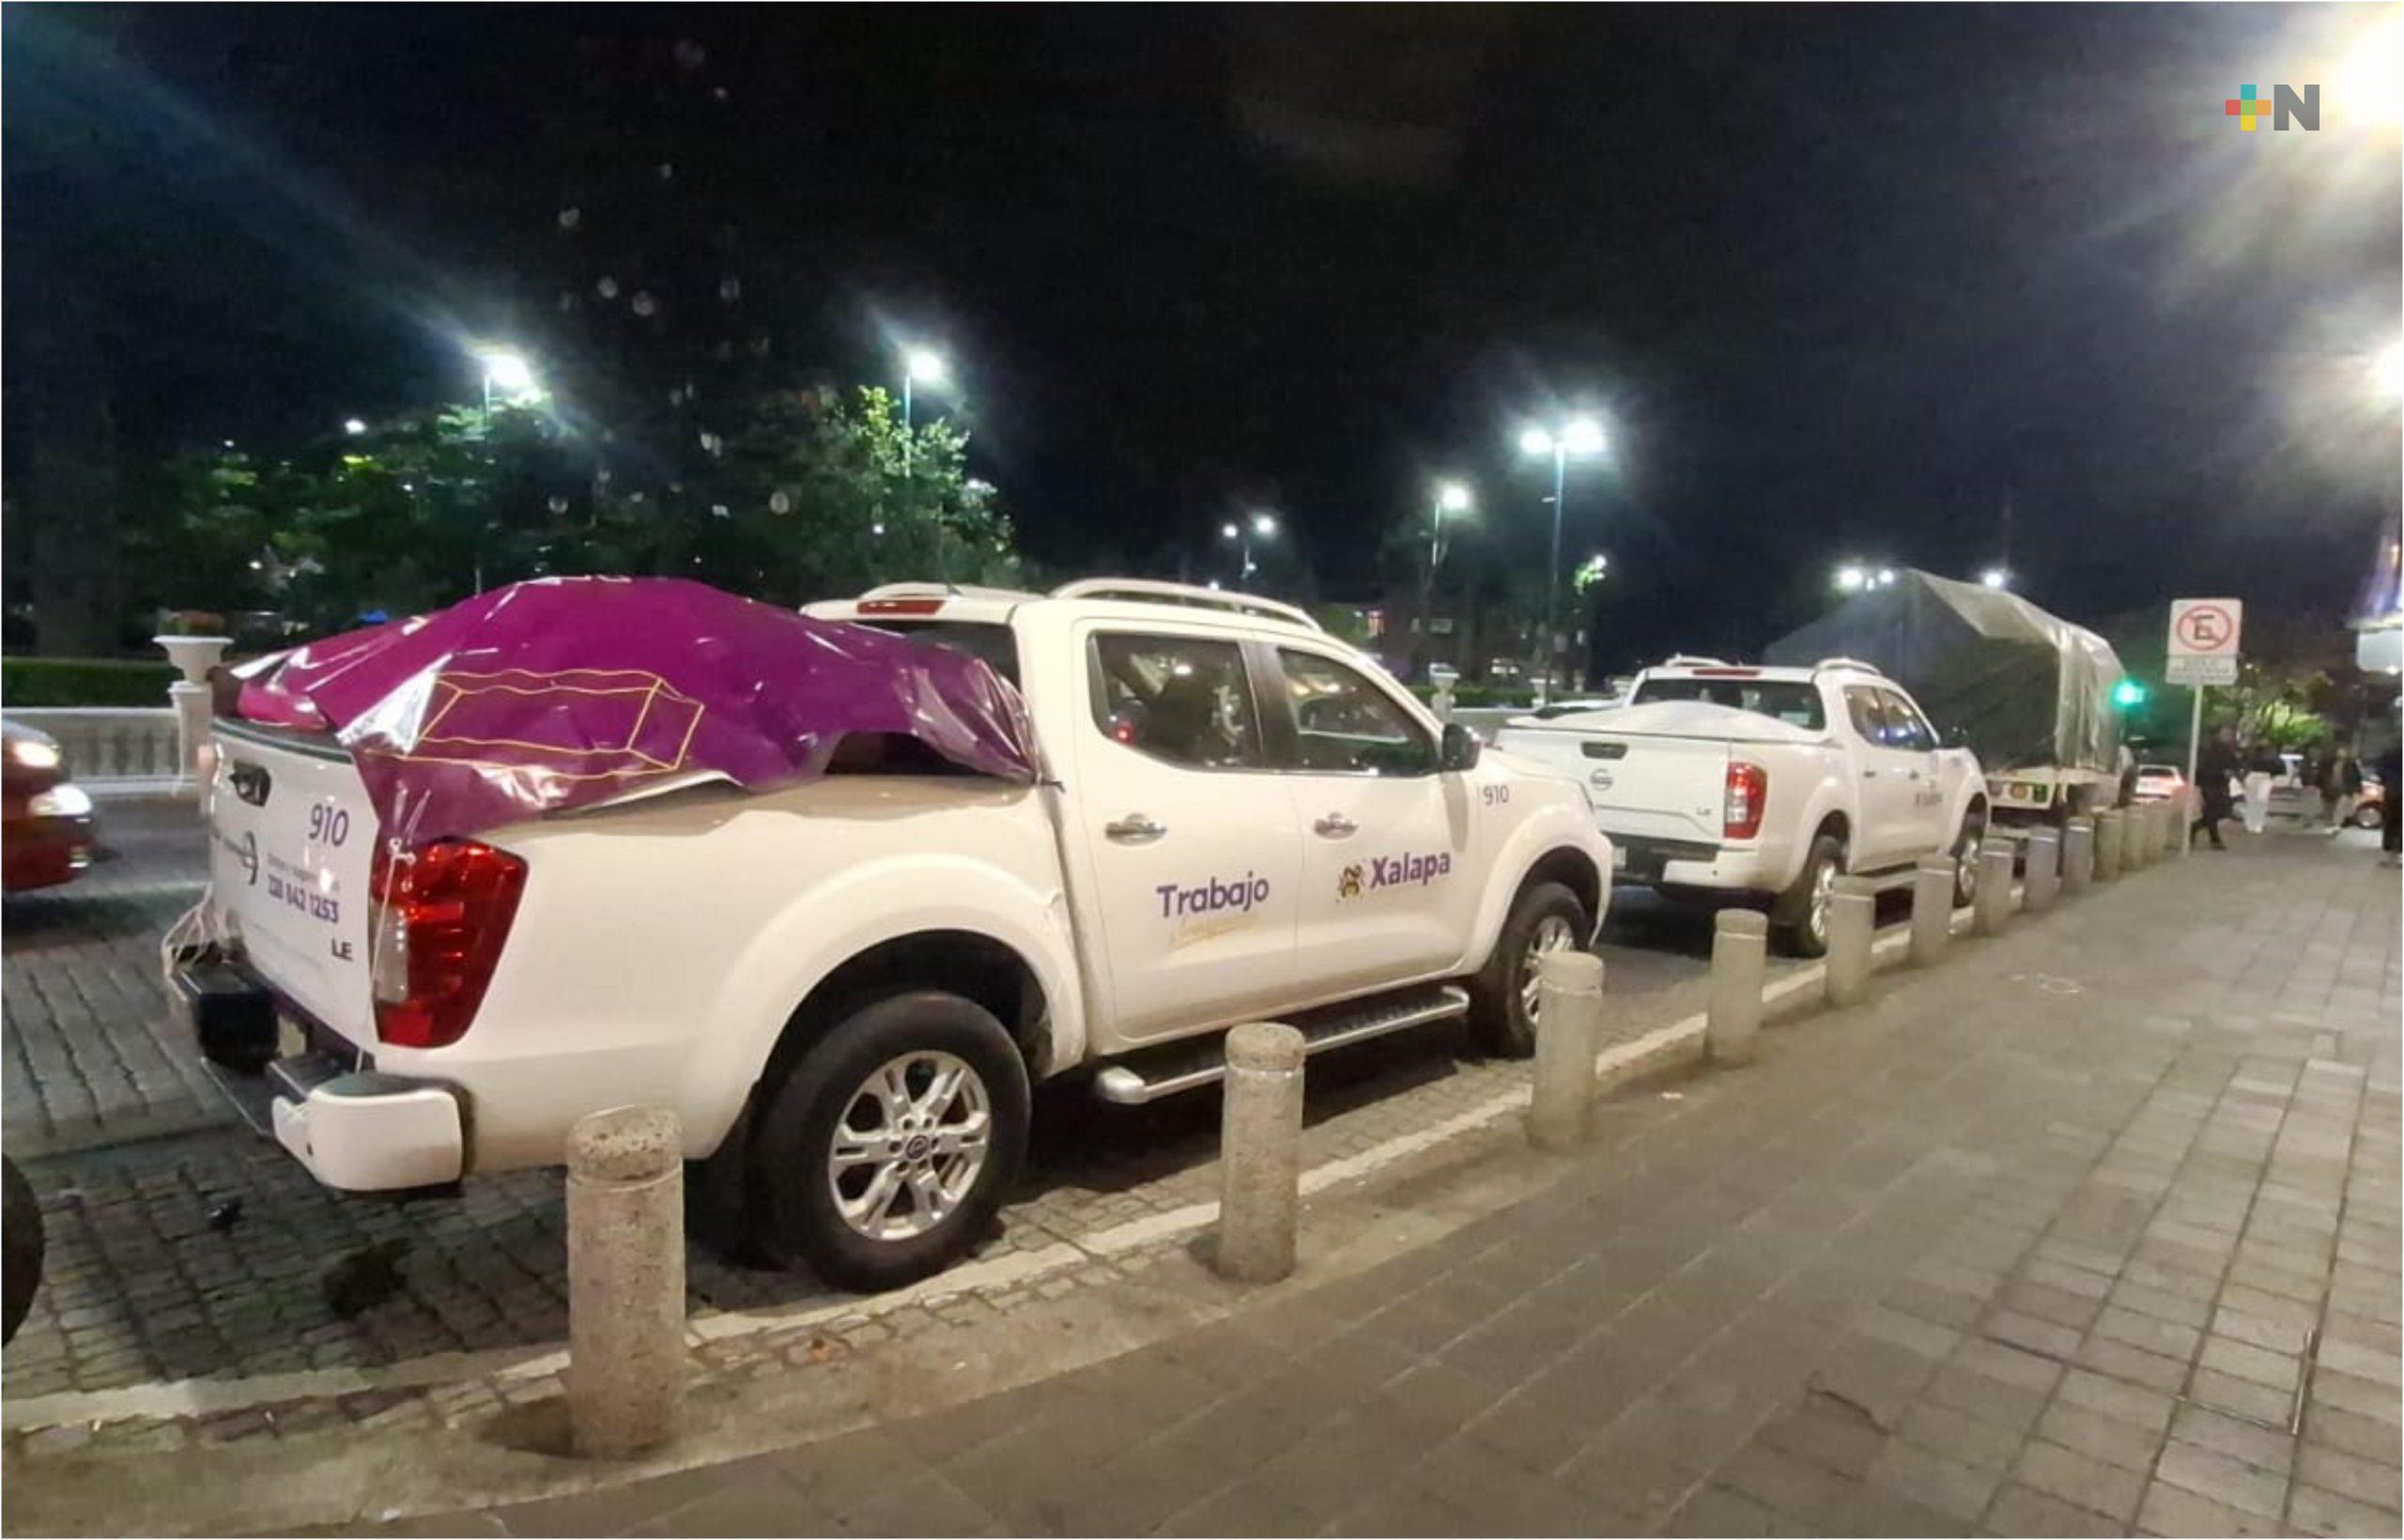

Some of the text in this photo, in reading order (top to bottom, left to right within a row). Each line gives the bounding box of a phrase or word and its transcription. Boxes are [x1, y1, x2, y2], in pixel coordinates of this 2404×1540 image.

[1483, 784, 1510, 806] 910
[309, 803, 348, 847] 910
[1370, 851, 1451, 888] Xalapa
[1156, 870, 1270, 918] Trabajo
[331, 938, 354, 962] LE
